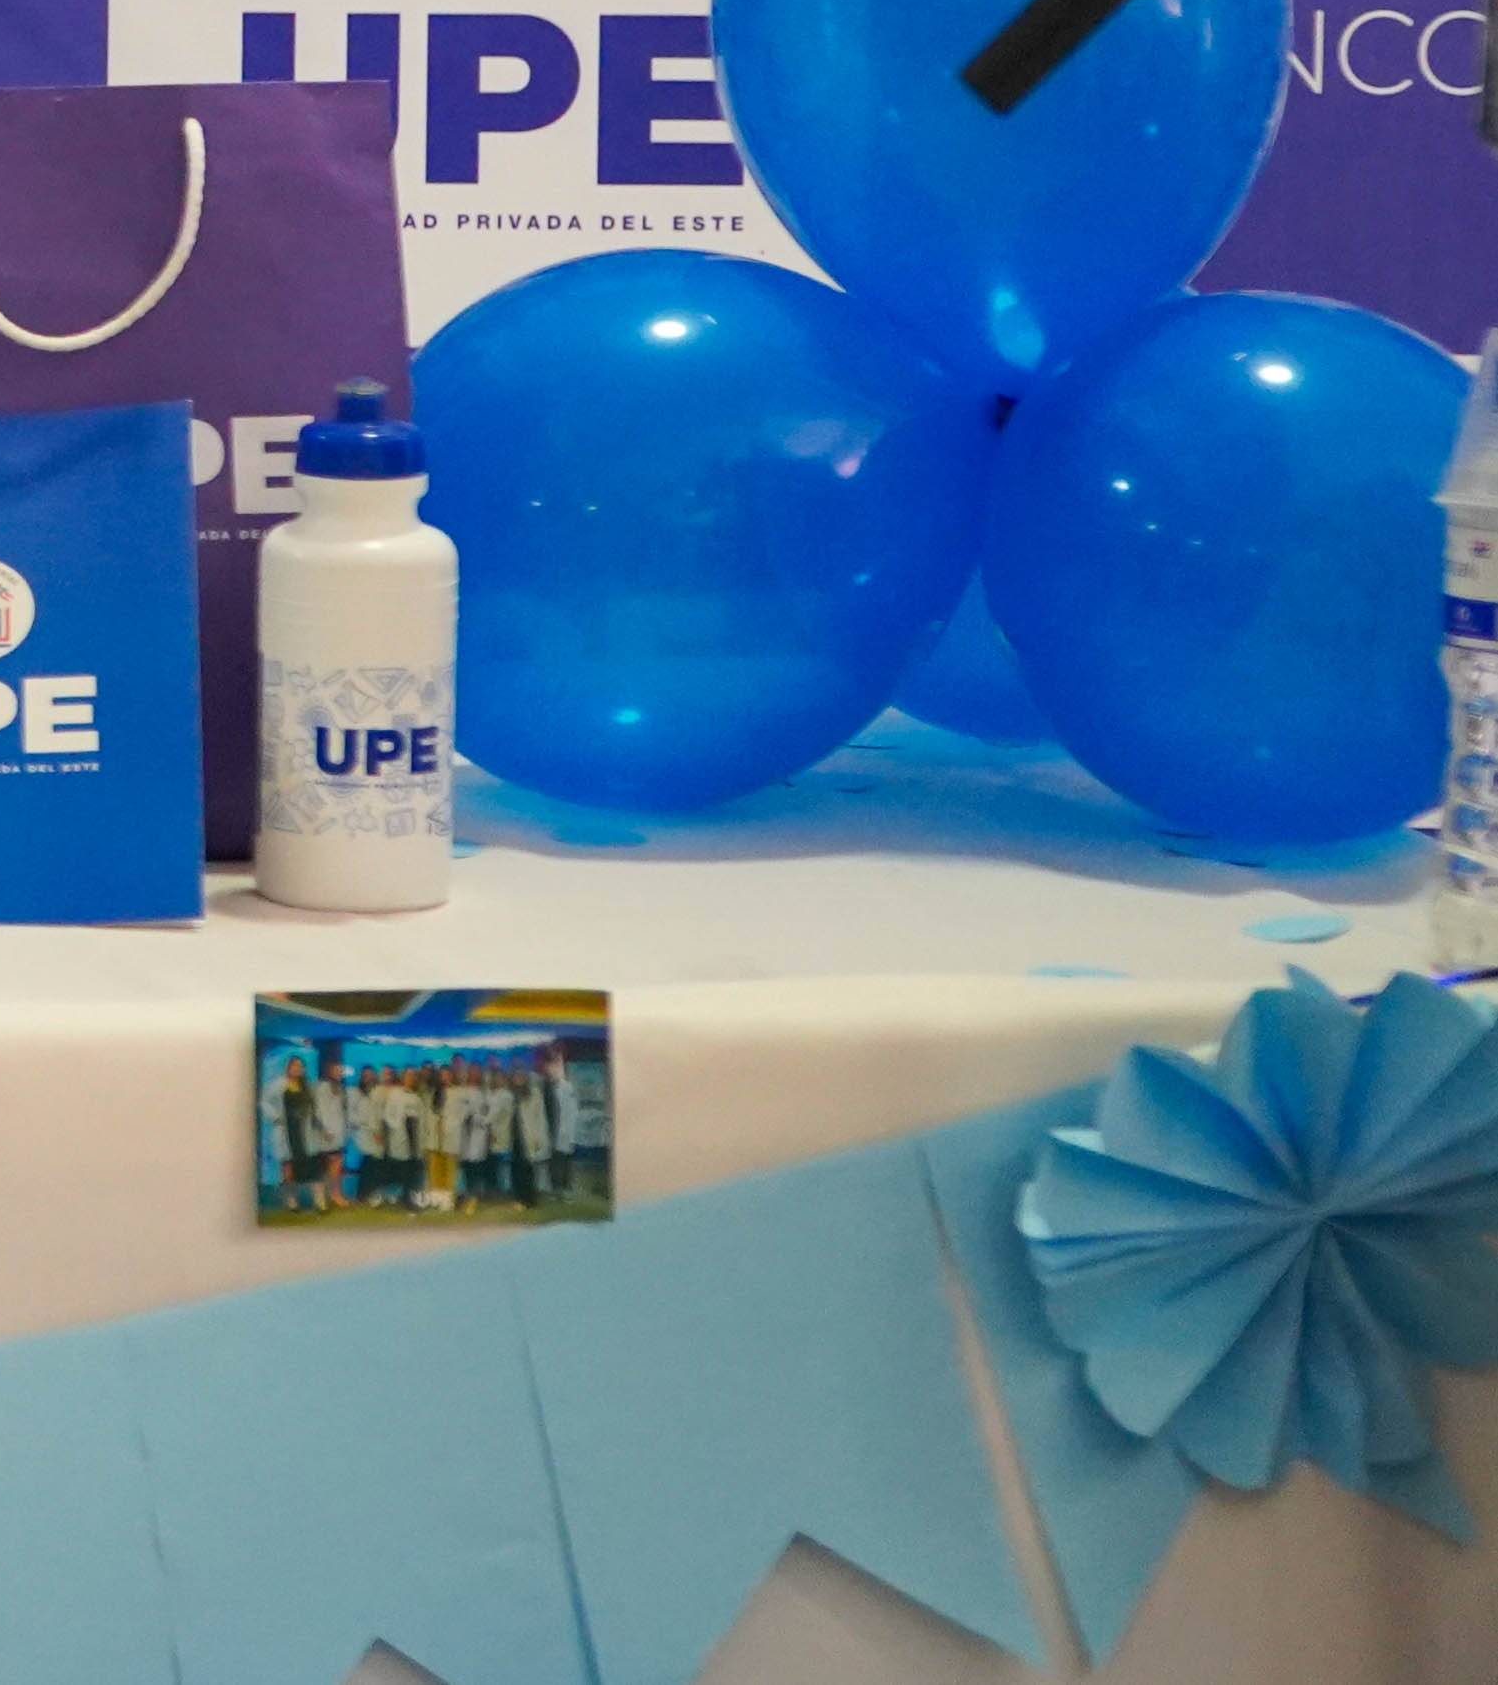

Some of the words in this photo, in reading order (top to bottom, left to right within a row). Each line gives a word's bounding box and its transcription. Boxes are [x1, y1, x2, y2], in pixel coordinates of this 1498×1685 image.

[457, 215, 582, 232] PRIVADA
[602, 216, 654, 232] DEL
[674, 216, 745, 232] ESTE
[314, 725, 440, 777] UPE
